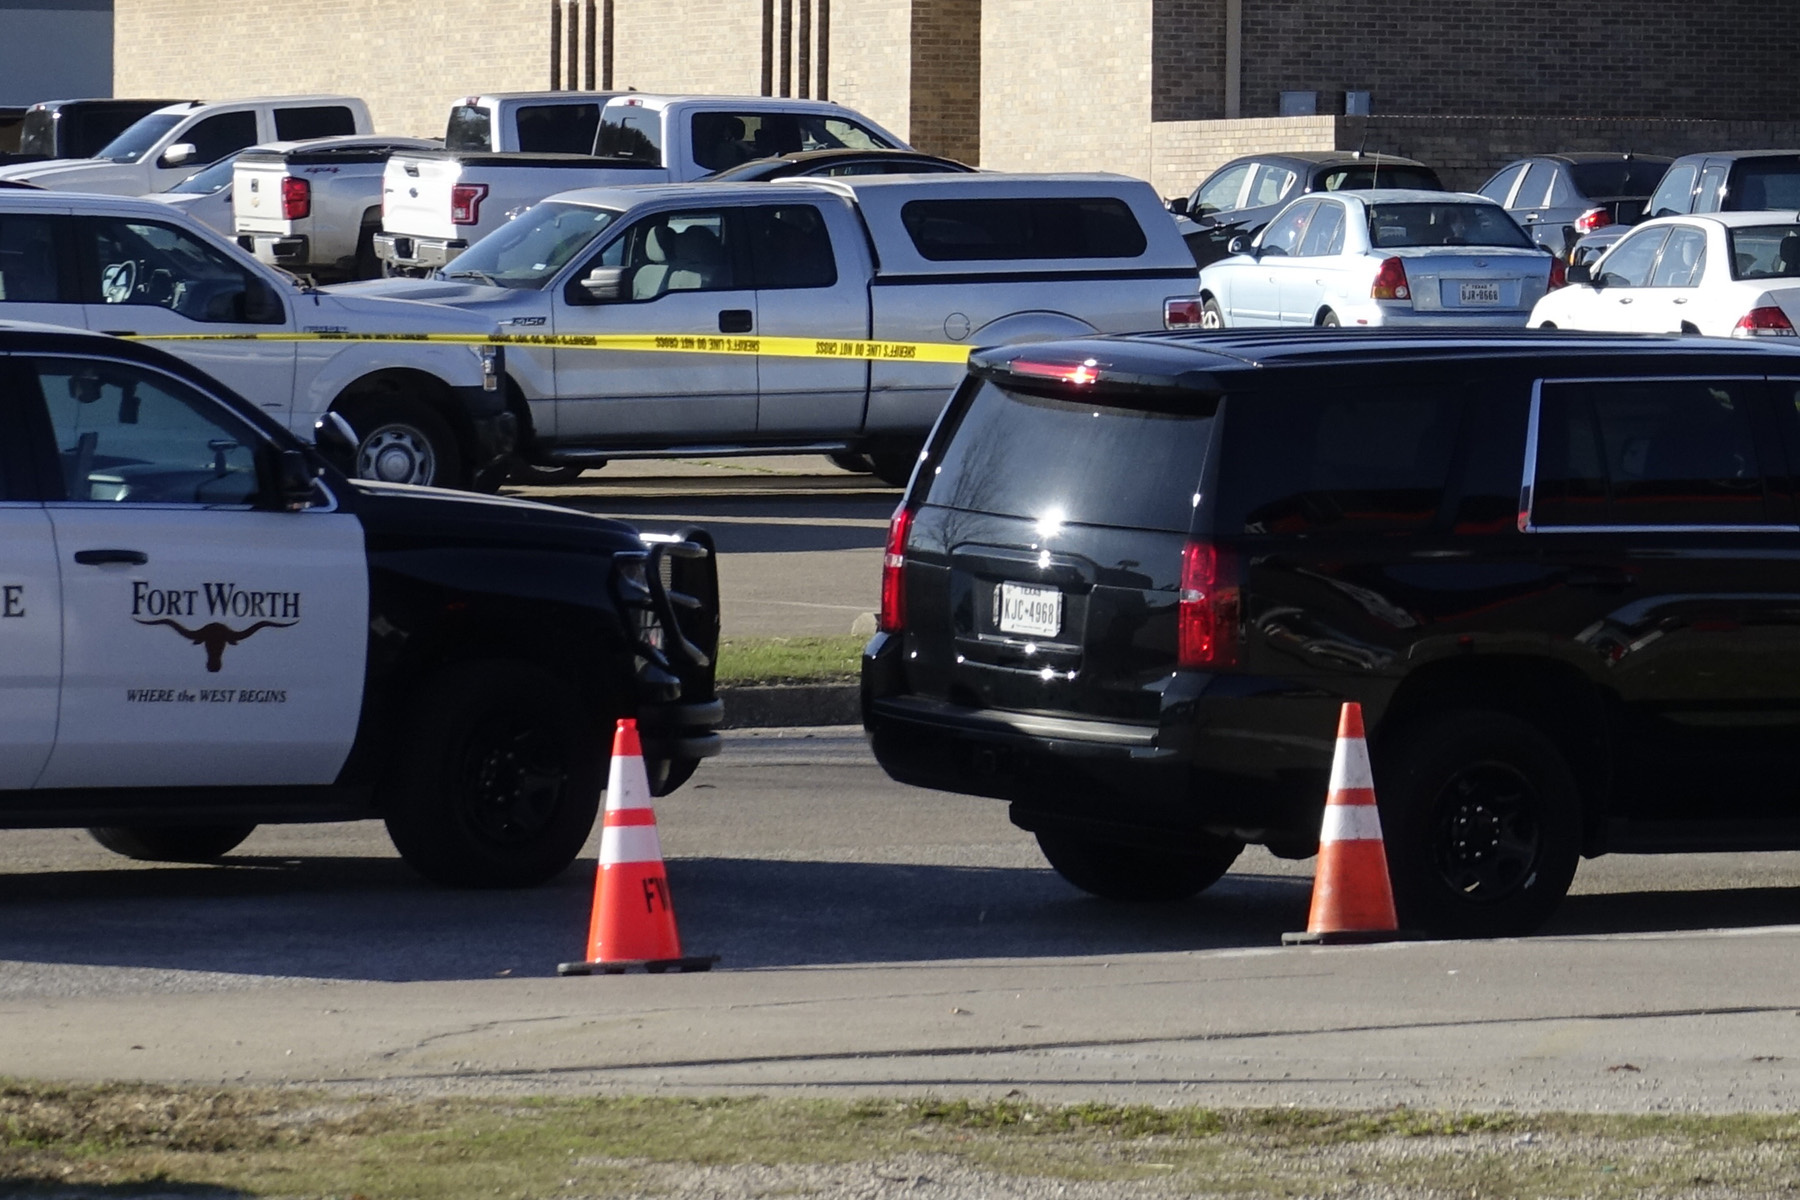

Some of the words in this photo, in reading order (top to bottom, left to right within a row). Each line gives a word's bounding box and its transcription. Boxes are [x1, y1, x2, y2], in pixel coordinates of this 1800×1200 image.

[815, 341, 838, 355] CROSS
[839, 342, 853, 356] NOT
[855, 343, 865, 356] DO
[866, 344, 882, 357] LINE
[883, 344, 917, 359] SHERIFF'S
[1020, 587, 1041, 597] TEXAS
[131, 581, 200, 616] FORT
[203, 582, 300, 618] WORTH
[126, 689, 176, 703] WHERE
[178, 689, 196, 703] the
[200, 689, 237, 703] WEST
[238, 689, 287, 703] BEGINS
